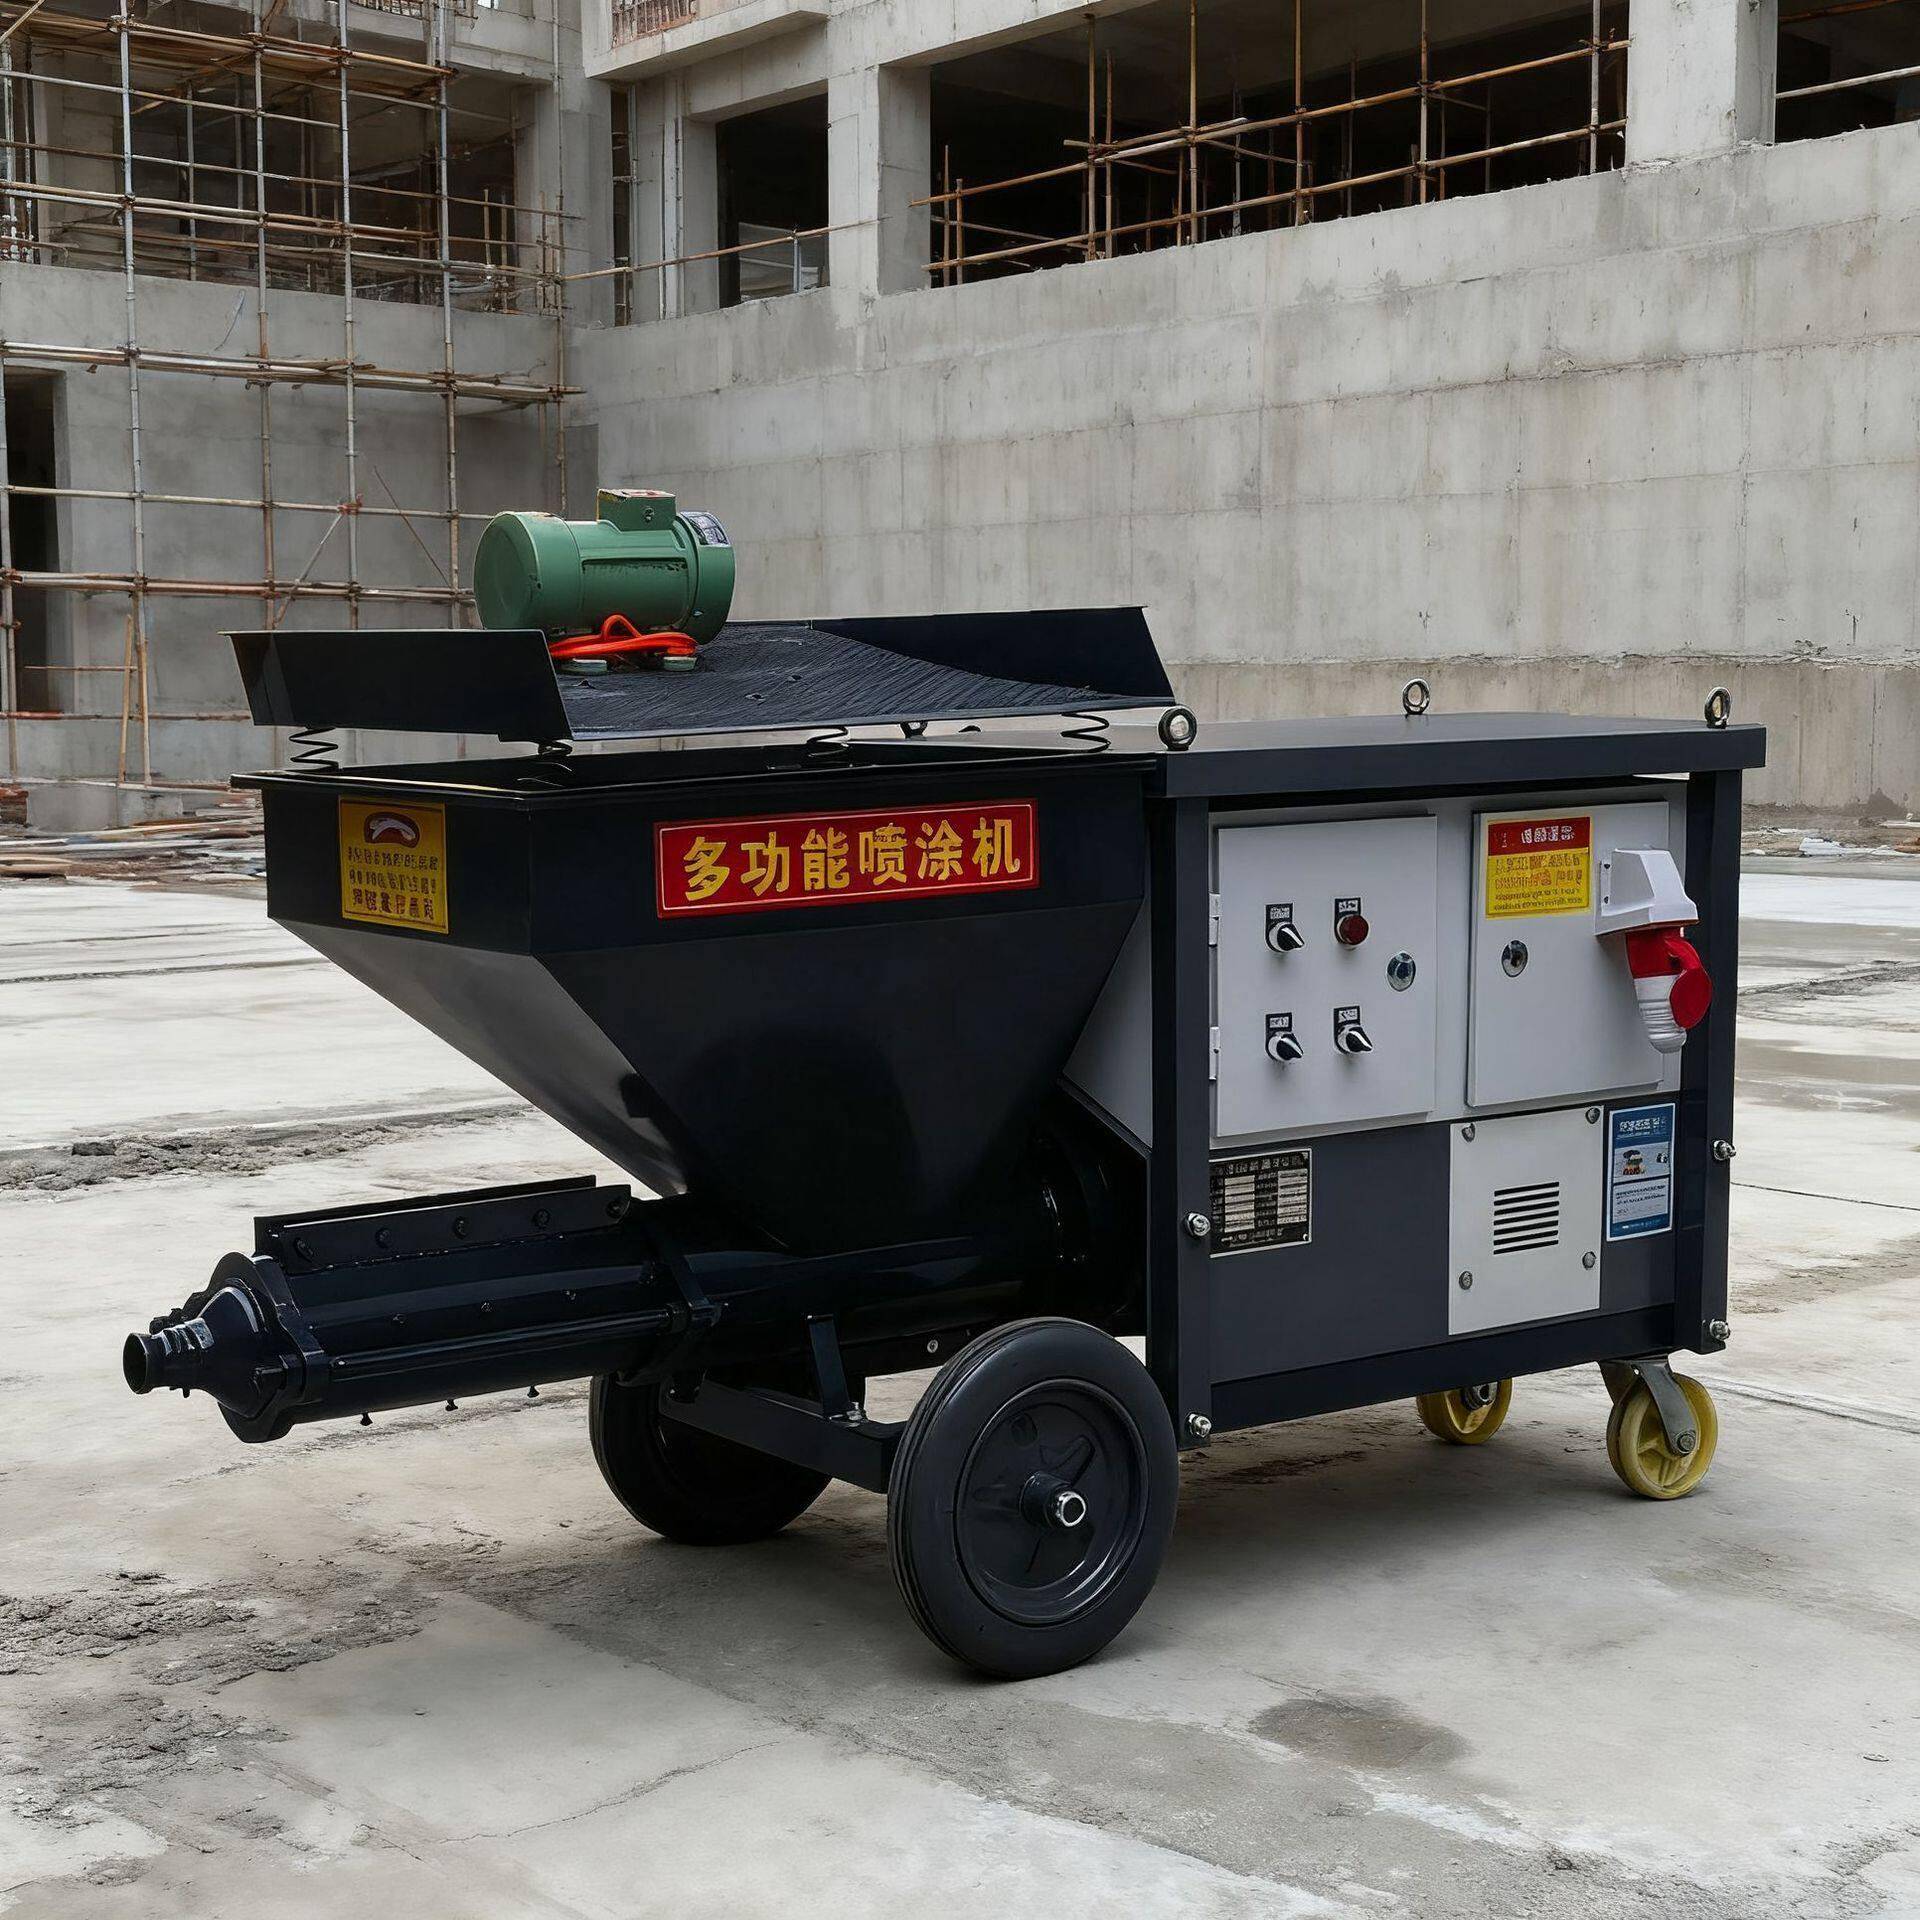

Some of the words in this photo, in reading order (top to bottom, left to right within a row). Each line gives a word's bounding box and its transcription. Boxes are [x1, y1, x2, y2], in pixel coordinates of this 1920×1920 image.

[683, 816, 1021, 901] 多功能喷涂机
